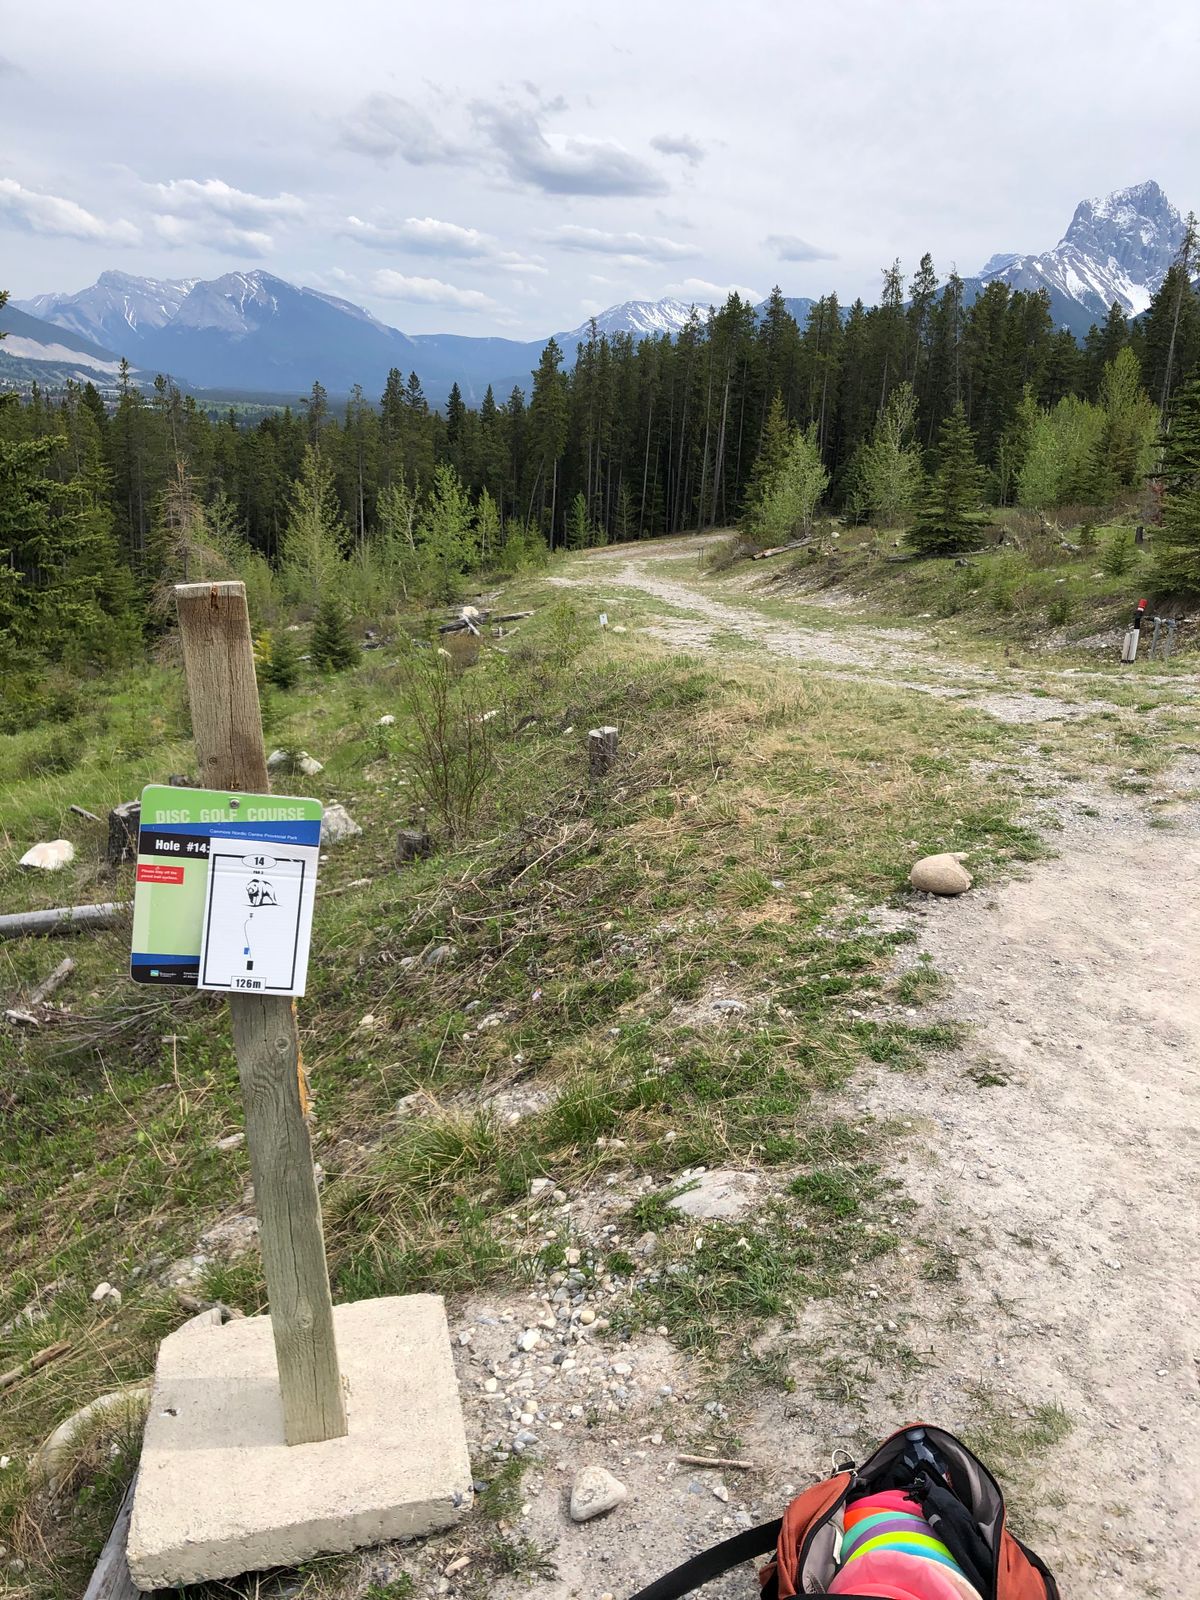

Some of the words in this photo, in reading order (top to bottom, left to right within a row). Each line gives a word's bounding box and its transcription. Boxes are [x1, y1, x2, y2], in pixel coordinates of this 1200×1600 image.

[155, 809, 190, 824] DISC
[200, 808, 238, 823] GOLF
[247, 807, 305, 821] COURSE
[155, 839, 180, 851] Hole
[254, 856, 265, 866] 14
[235, 978, 261, 989] 126m
